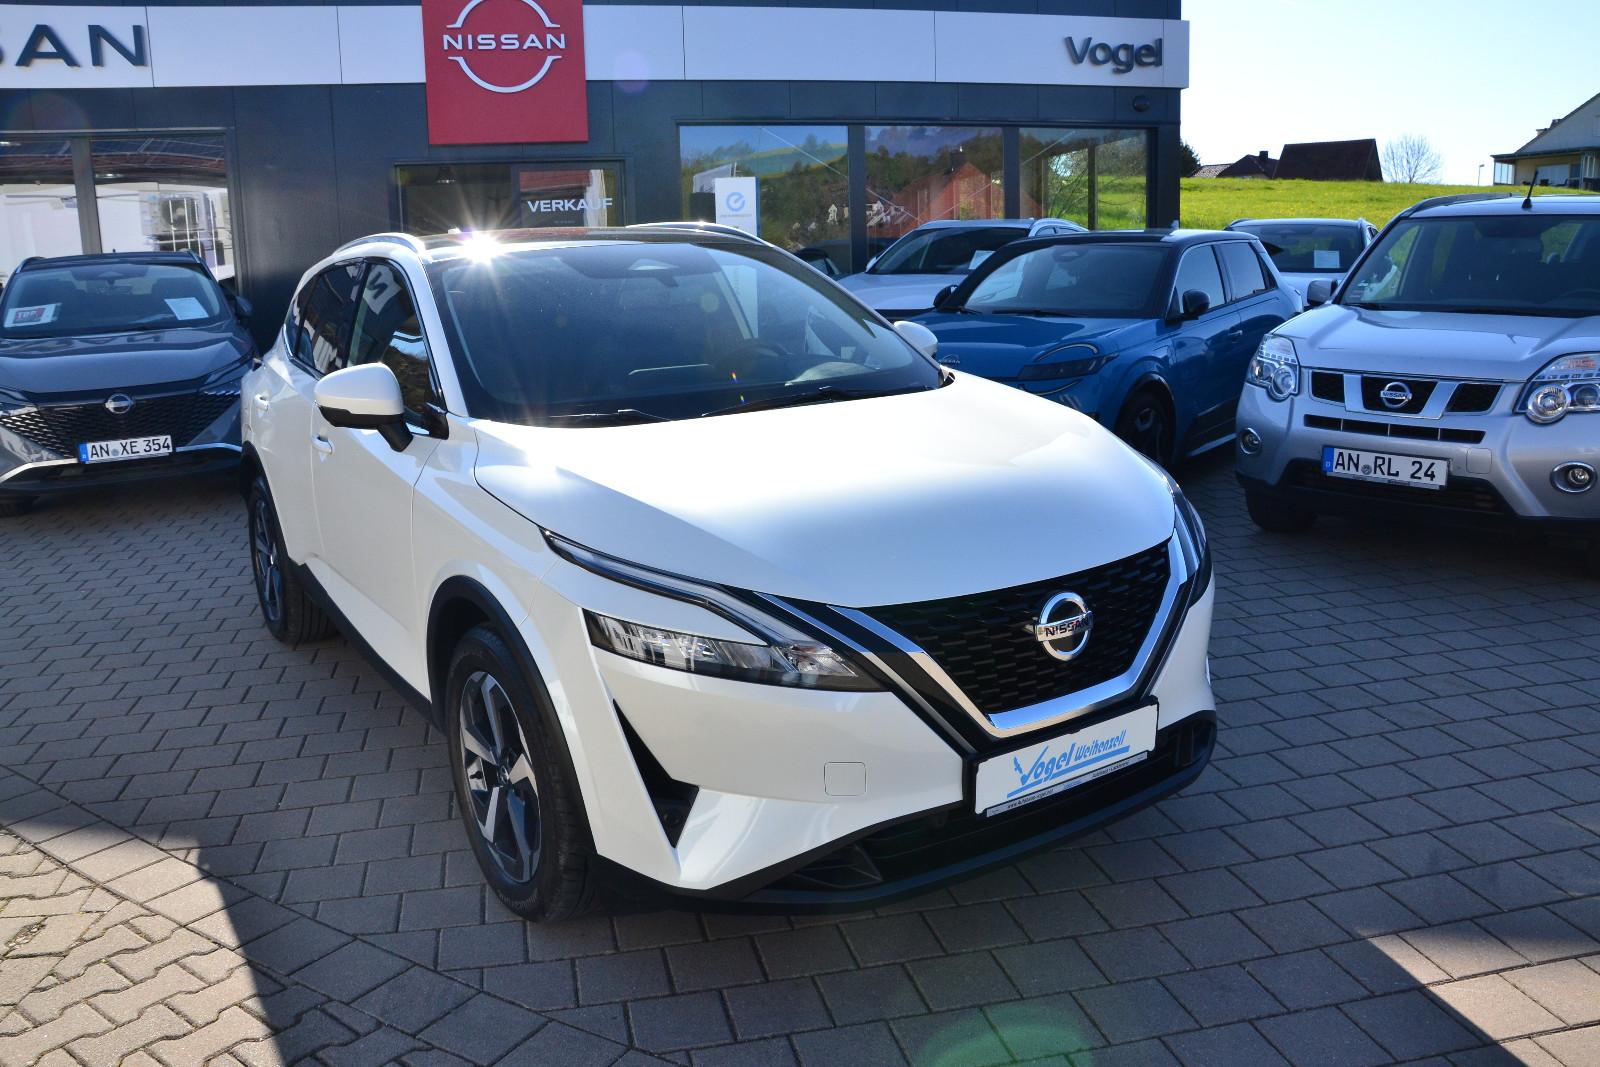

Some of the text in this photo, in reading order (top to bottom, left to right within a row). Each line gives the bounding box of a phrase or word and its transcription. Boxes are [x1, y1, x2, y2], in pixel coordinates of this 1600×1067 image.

[0, 24, 147, 67] AN
[443, 33, 566, 51] NISSAN
[1065, 37, 1163, 74] Vogel
[527, 197, 613, 213] VERKAUF
[91, 444, 110, 458] AN
[120, 441, 140, 455] XE
[144, 438, 170, 453] 354
[1335, 452, 1360, 472] AN
[1374, 456, 1399, 476] RL
[1411, 461, 1436, 481] 24
[1045, 618, 1089, 637] NISSAN
[1013, 743, 1076, 785] Vogel
[1075, 730, 1126, 760] Weihenzell
